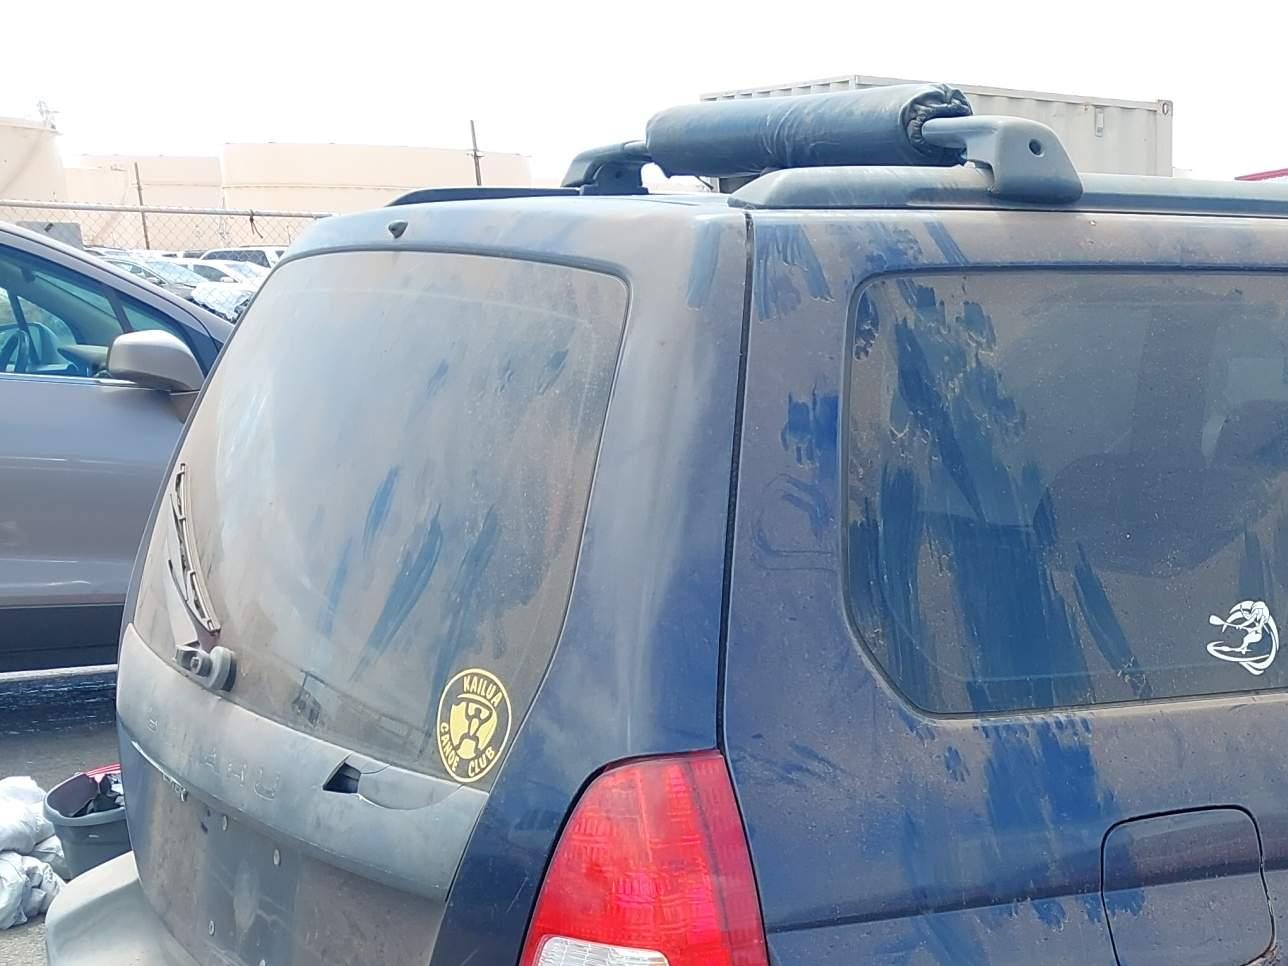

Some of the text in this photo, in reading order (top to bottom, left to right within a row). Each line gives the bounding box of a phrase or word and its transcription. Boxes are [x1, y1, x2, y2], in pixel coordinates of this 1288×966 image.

[463, 675, 502, 707] KAILUA
[441, 722, 495, 776] CANOE CLUB
